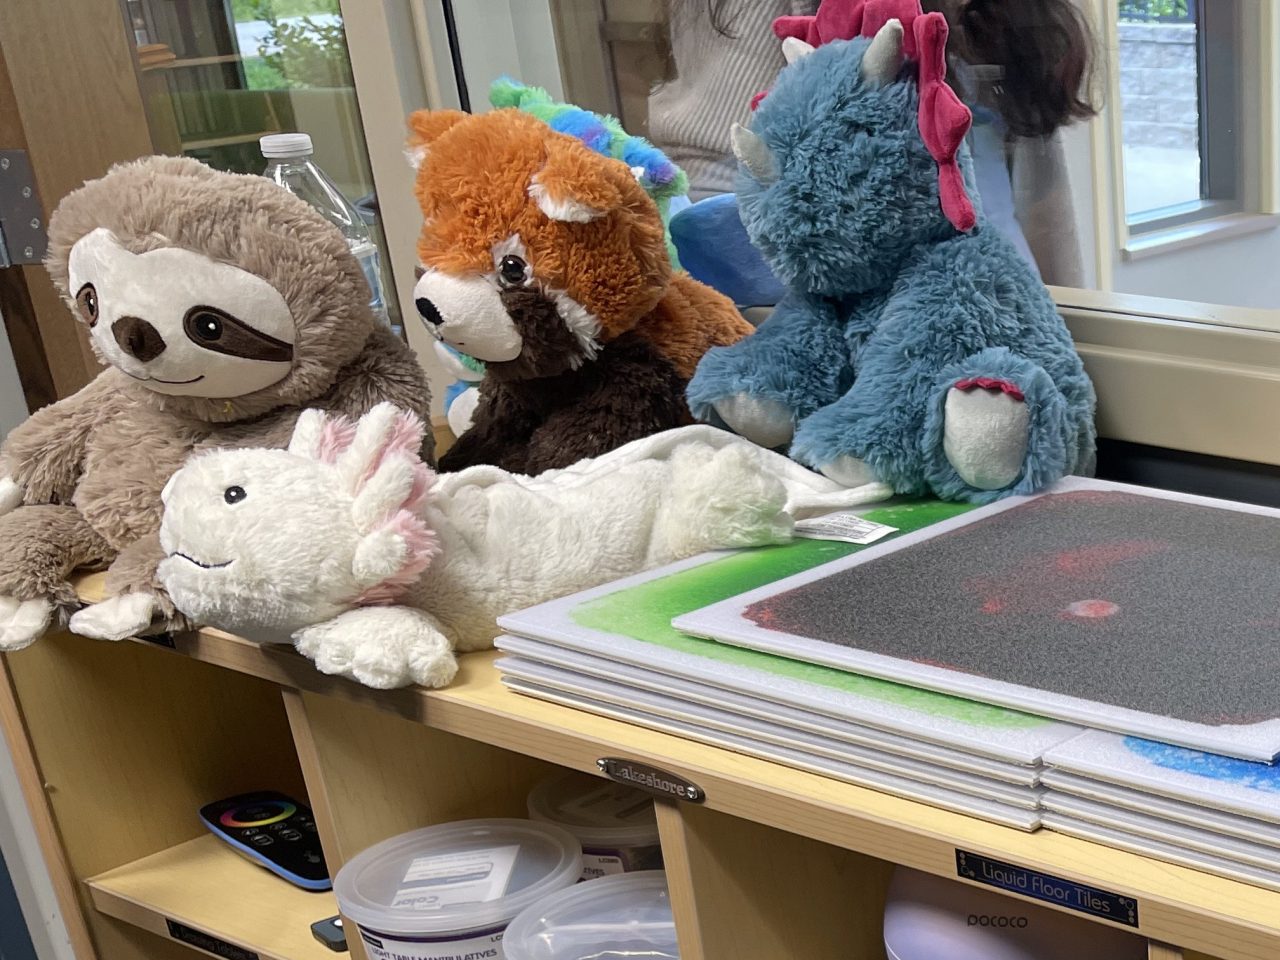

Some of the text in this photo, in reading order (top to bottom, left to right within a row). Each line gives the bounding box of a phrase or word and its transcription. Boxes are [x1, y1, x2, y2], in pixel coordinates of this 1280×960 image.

[982, 862, 1111, 913] Liquid Floor Tiles
[967, 914, 1029, 928] pococo
